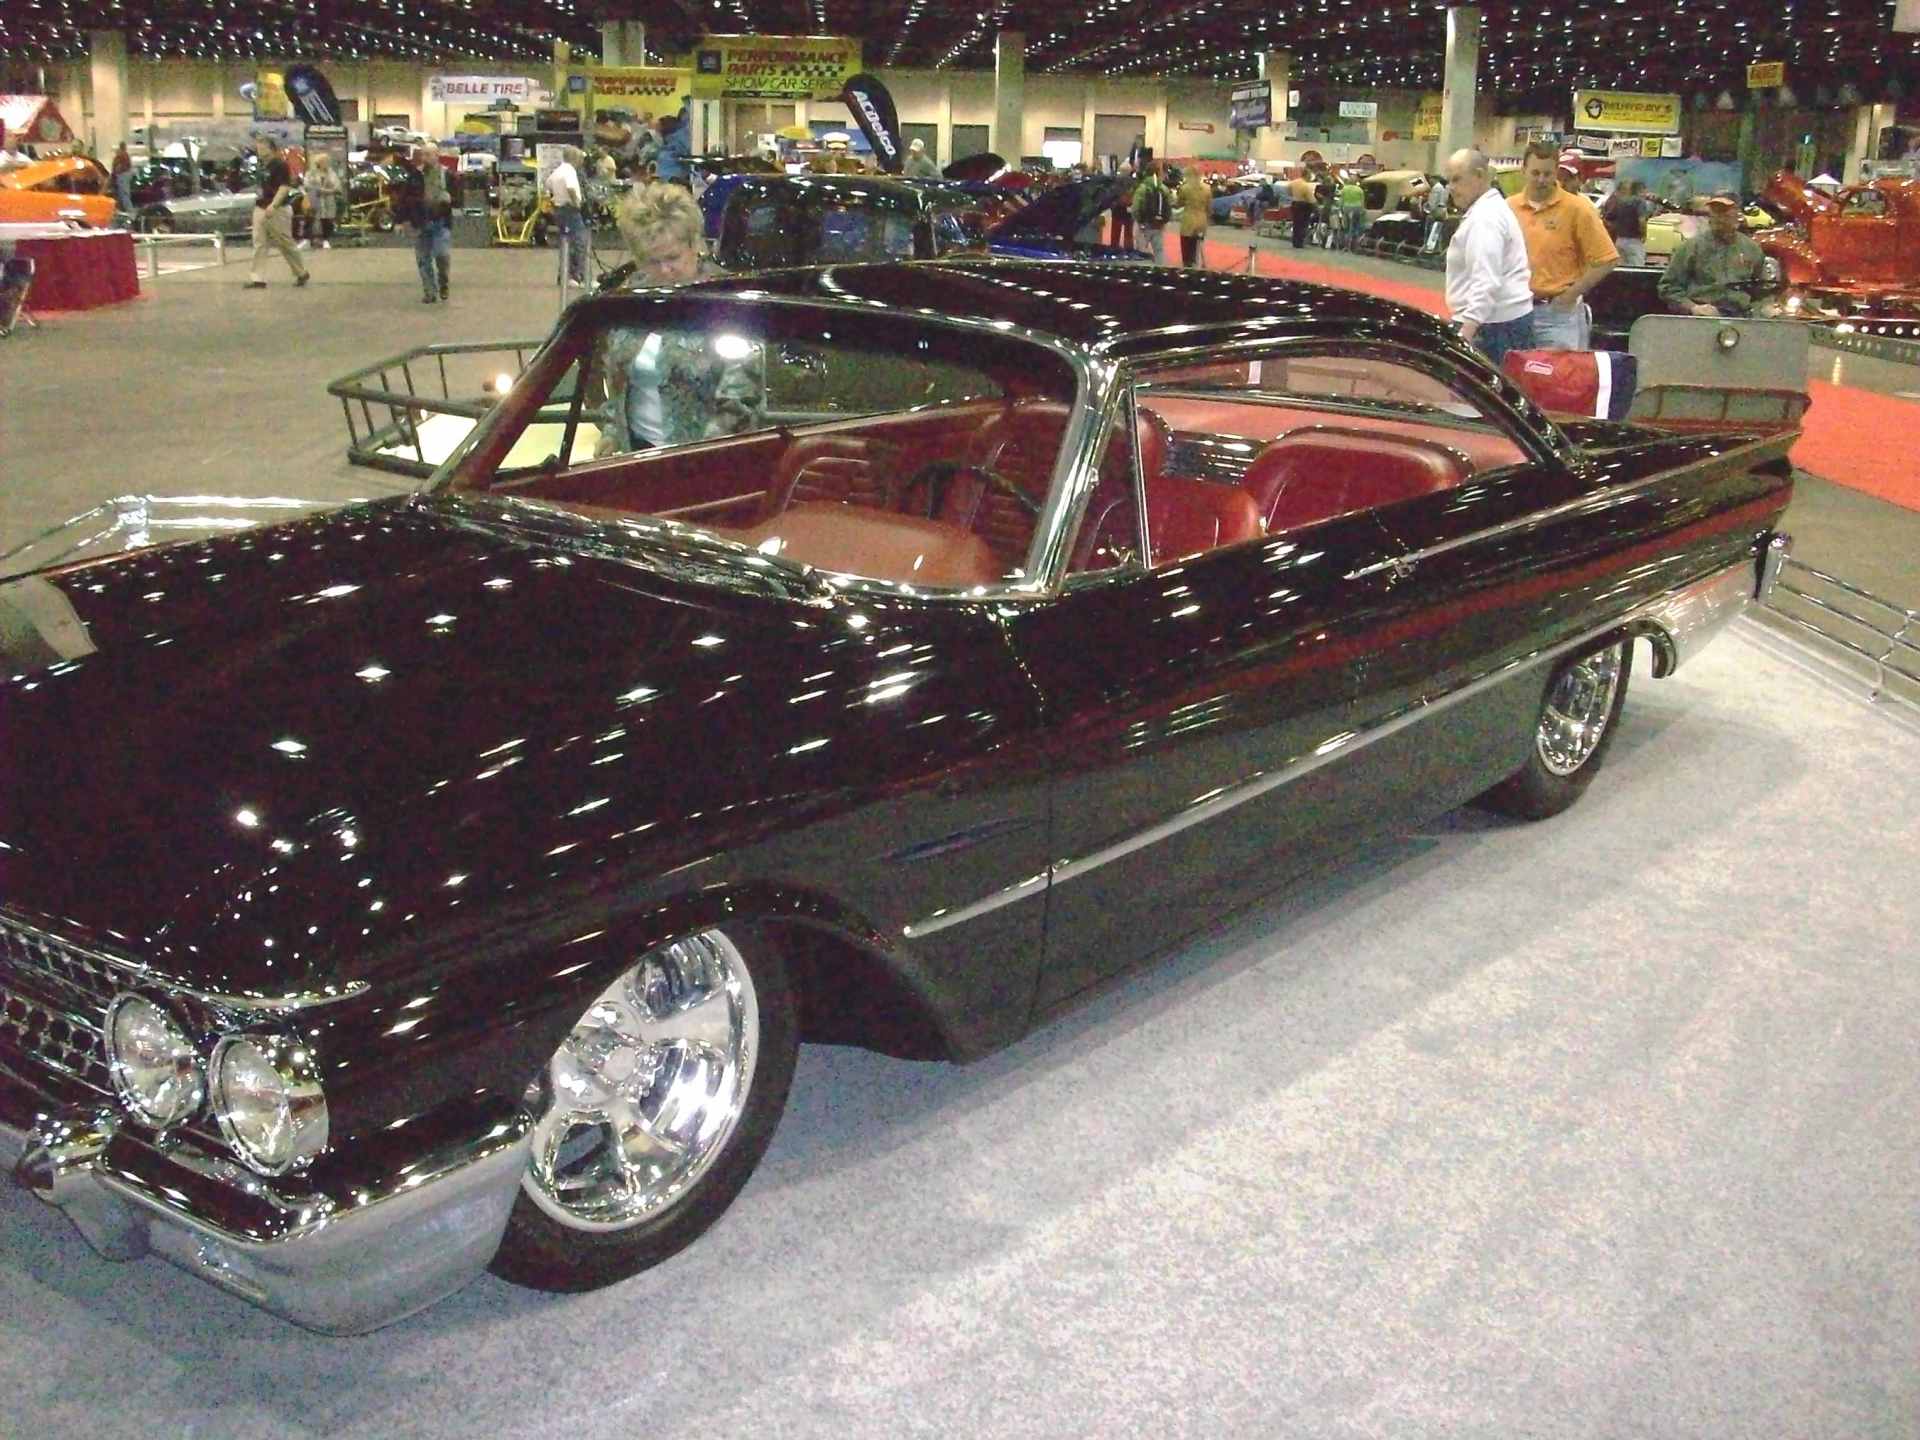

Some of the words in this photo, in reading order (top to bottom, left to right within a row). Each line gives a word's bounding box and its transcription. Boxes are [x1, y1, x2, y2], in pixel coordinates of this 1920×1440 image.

[727, 63, 777, 76] PARTS
[446, 82, 489, 95] BELLE
[493, 83, 523, 95] TIRE
[725, 77, 767, 90] SHOW
[771, 77, 797, 89] CAR
[1612, 140, 1638, 150] MSD
